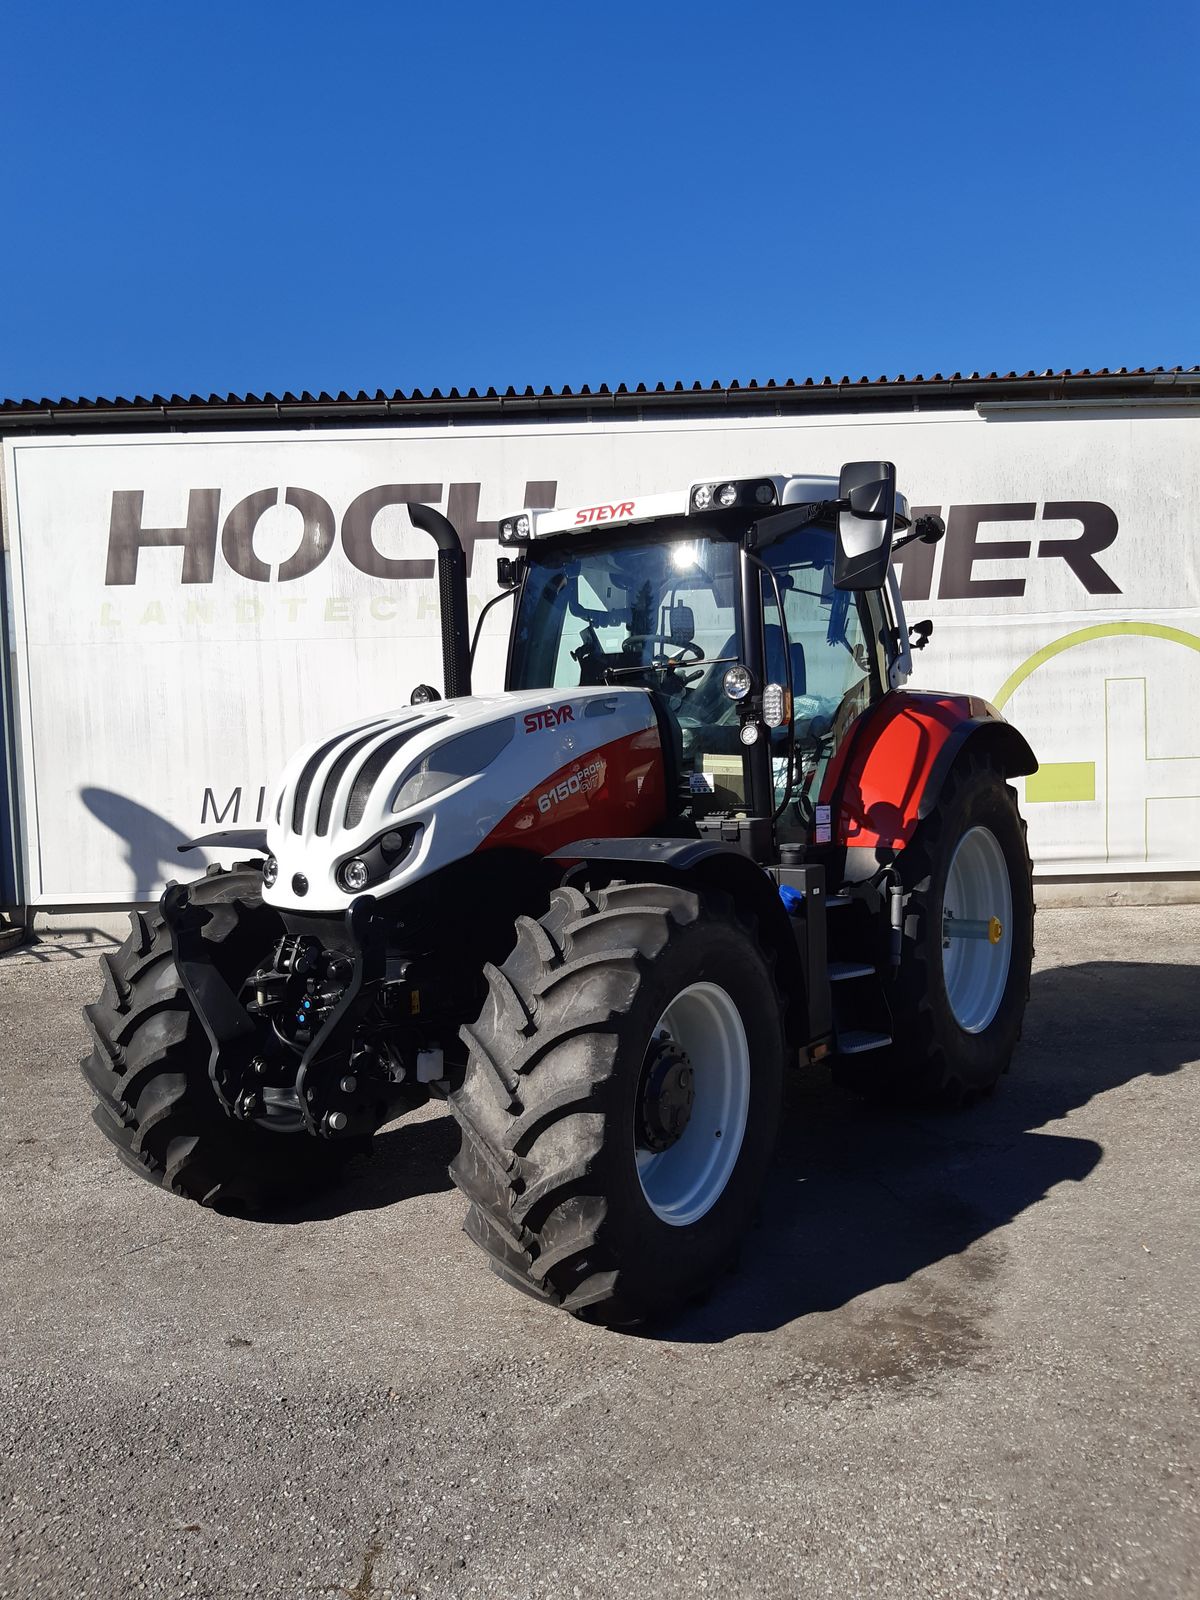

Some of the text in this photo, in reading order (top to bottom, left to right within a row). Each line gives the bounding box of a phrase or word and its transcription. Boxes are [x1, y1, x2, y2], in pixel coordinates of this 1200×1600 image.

[575, 502, 635, 525] STEYR
[524, 704, 575, 733] STEYR
[537, 775, 580, 814] 6150
